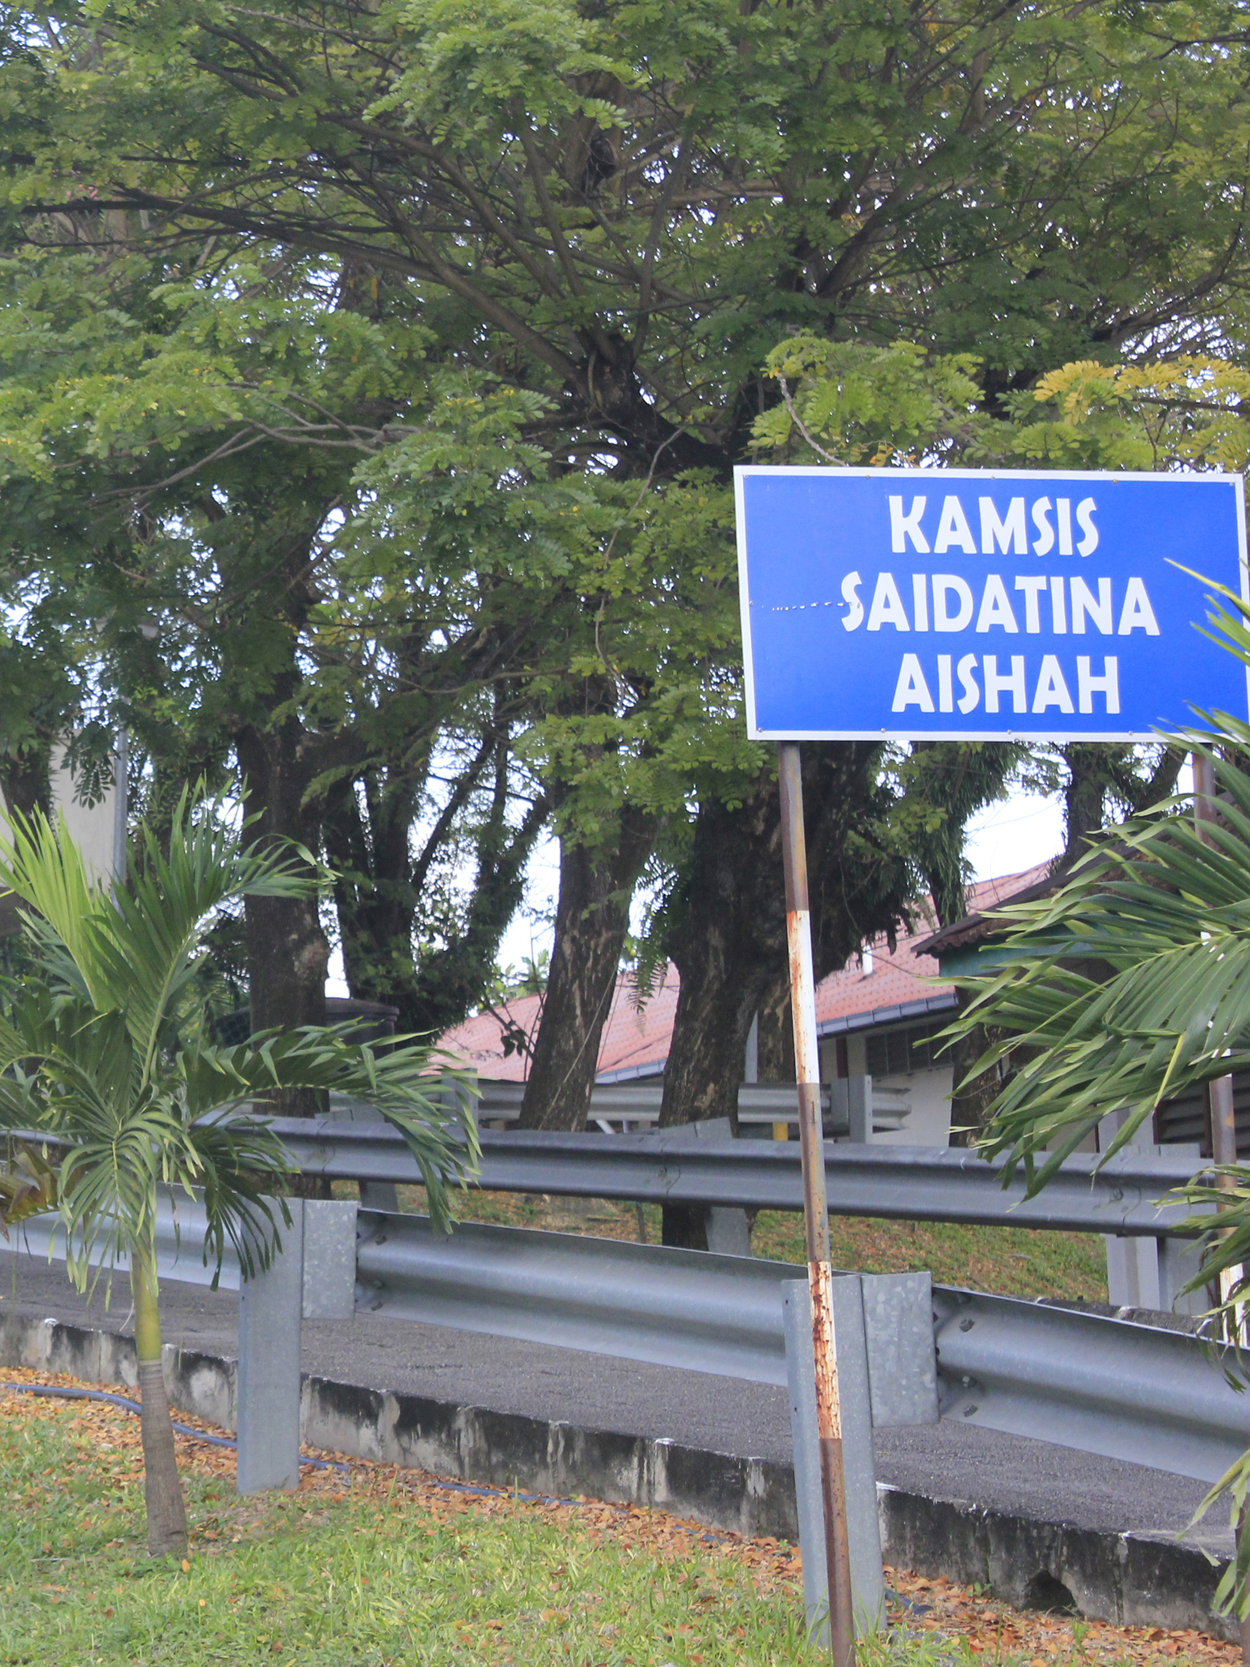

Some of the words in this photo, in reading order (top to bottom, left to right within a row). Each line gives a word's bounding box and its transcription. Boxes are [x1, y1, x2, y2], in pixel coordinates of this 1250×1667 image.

[888, 495, 1100, 558] KAMSIS
[840, 571, 1161, 636] SAIDATINA
[891, 653, 1121, 715] AISHAH
